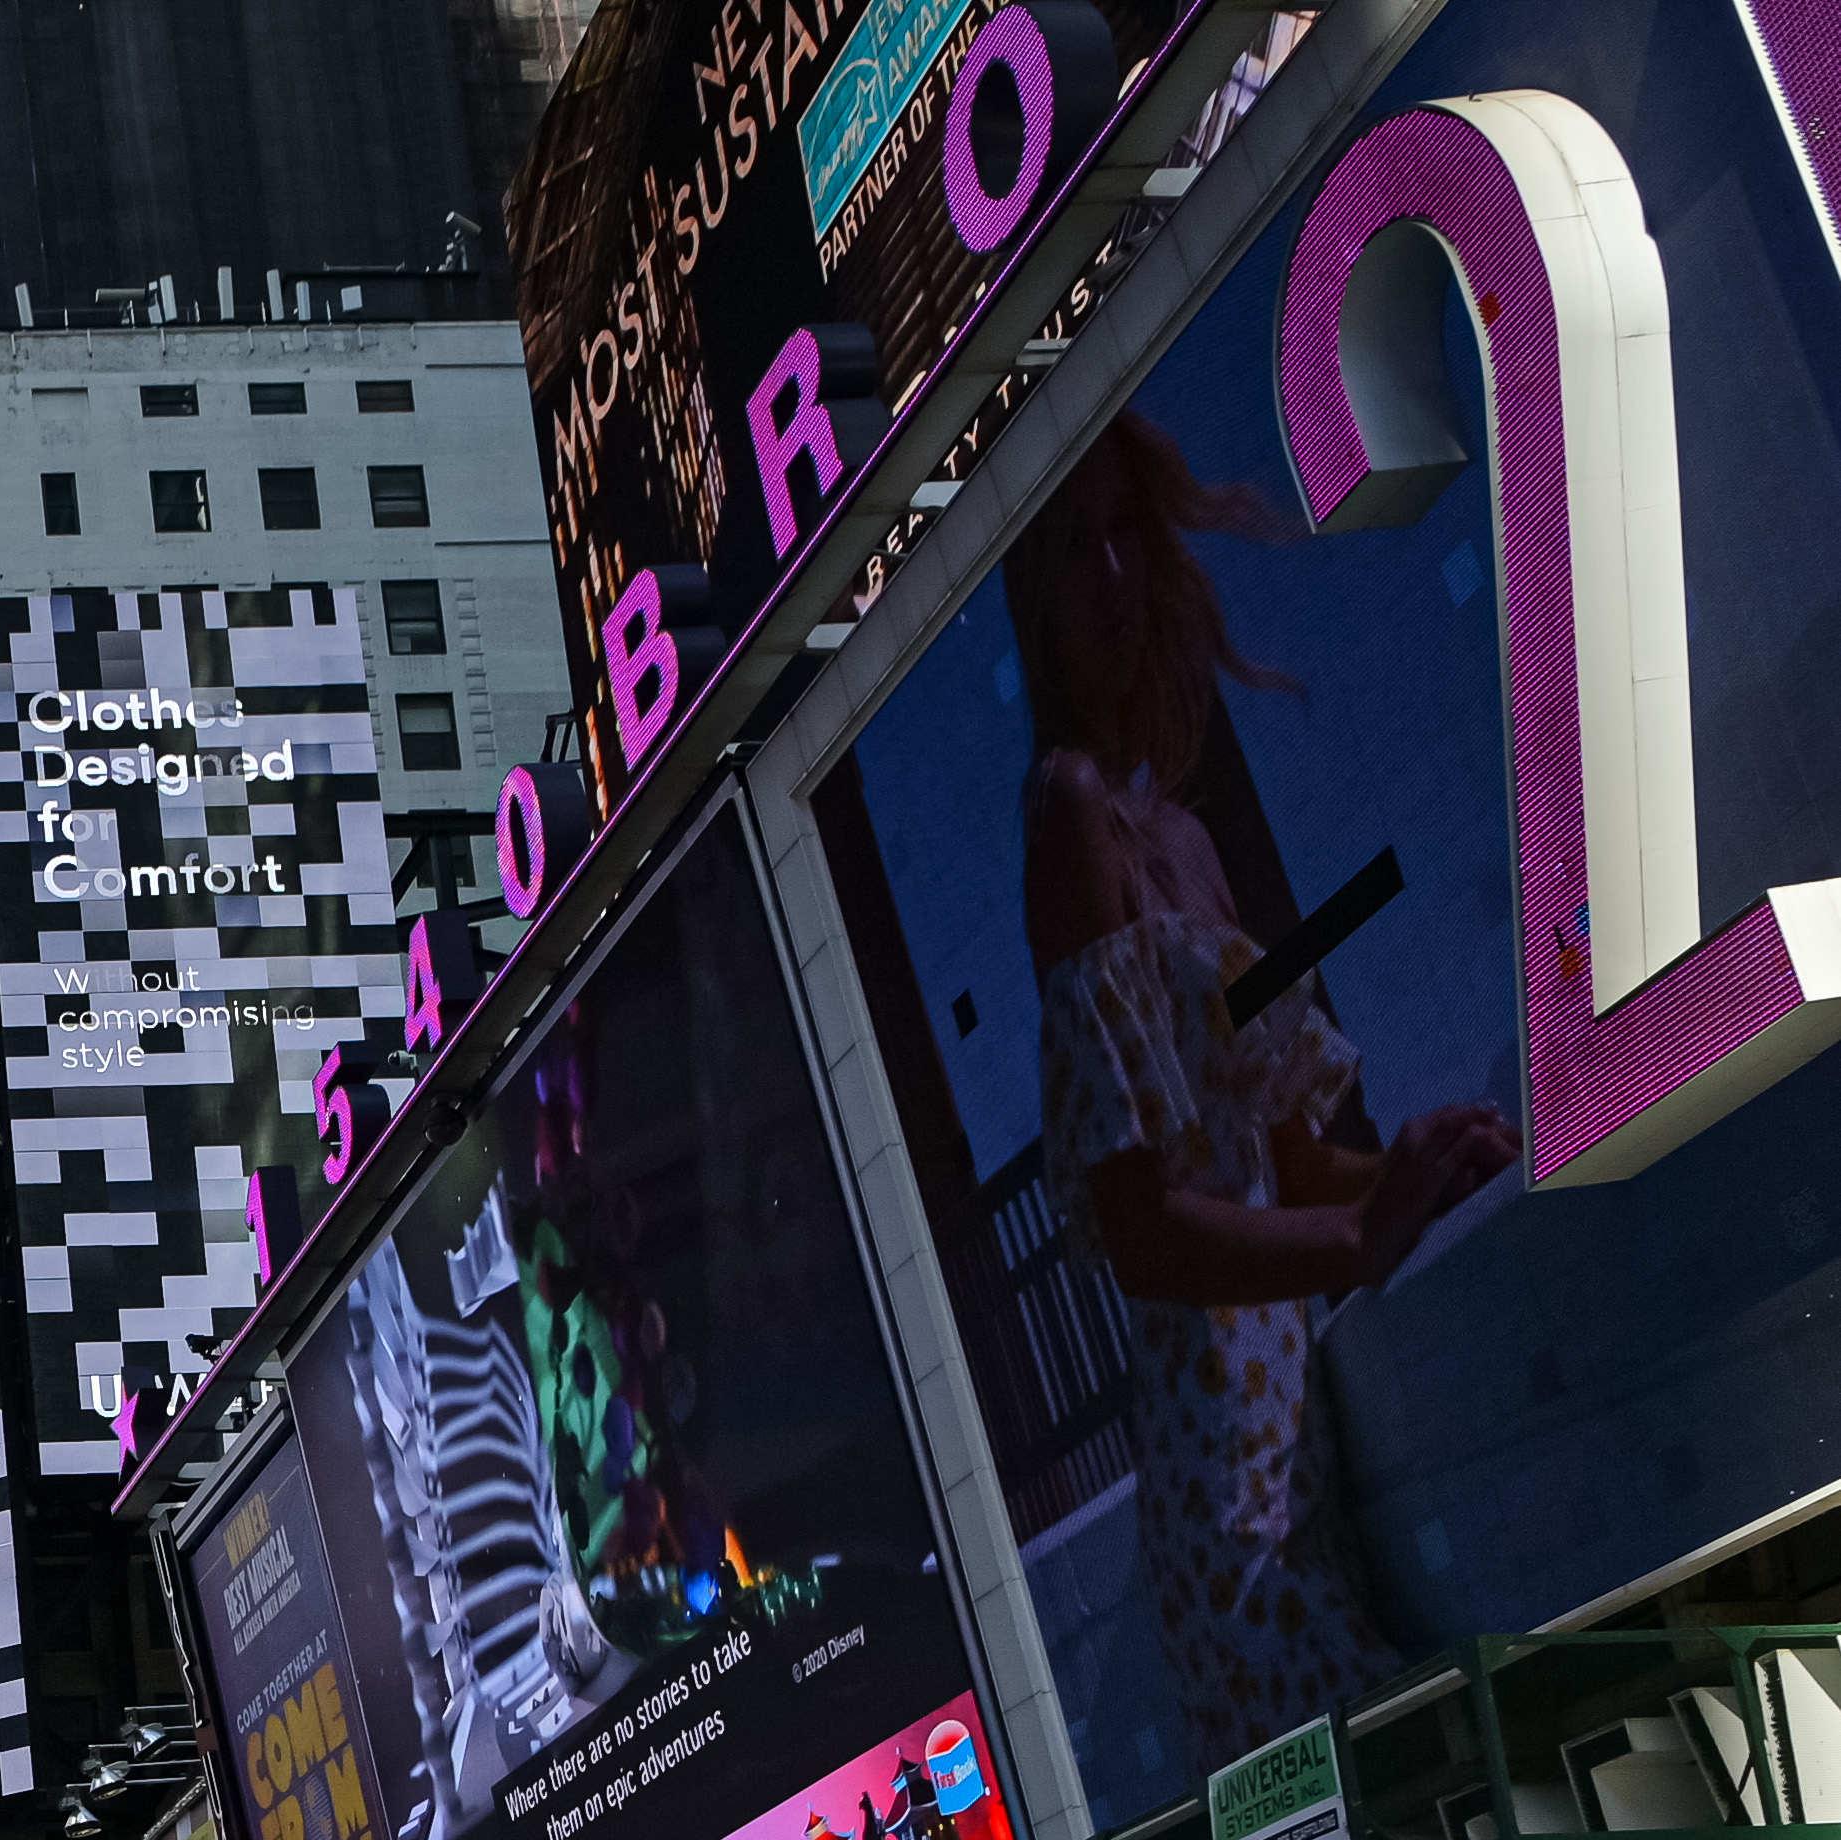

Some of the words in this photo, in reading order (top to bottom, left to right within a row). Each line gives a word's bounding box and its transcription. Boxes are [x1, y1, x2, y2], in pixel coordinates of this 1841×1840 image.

[819, 136, 907, 285] PARTNER
[909, 86, 935, 142] OF
[553, 238, 661, 496] MOST
[29, 689, 244, 735] Clothes
[36, 739, 294, 795] Designed
[38, 803, 116, 843] for
[44, 853, 287, 900] Comfort
[59, 1000, 315, 1034] compromising
[60, 1040, 146, 1073] style
[223, 1570, 251, 1630] BEST
[248, 1524, 295, 1606] MUSICAL
[237, 1703, 263, 1734] COME
[262, 1652, 314, 1706] TOGETHER
[315, 1629, 329, 1657] AT
[803, 1647, 829, 1677] 2020
[827, 1624, 866, 1661] Disney
[247, 1663, 348, 1809] COME
[504, 1777, 548, 1822] Where
[548, 1754, 587, 1801] there
[588, 1735, 613, 1765] are
[614, 1715, 635, 1748] no
[636, 1674, 690, 1731] stories
[691, 1659, 712, 1690] to
[713, 1629, 753, 1675] take
[585, 1790, 604, 1822] on
[606, 1767, 638, 1811] epic
[639, 1708, 726, 1786] adventures
[1218, 1734, 1326, 1814] UNIVERSAL
[1225, 1785, 1296, 1838] SYSTEMS
[1299, 1779, 1325, 1800] INC.
